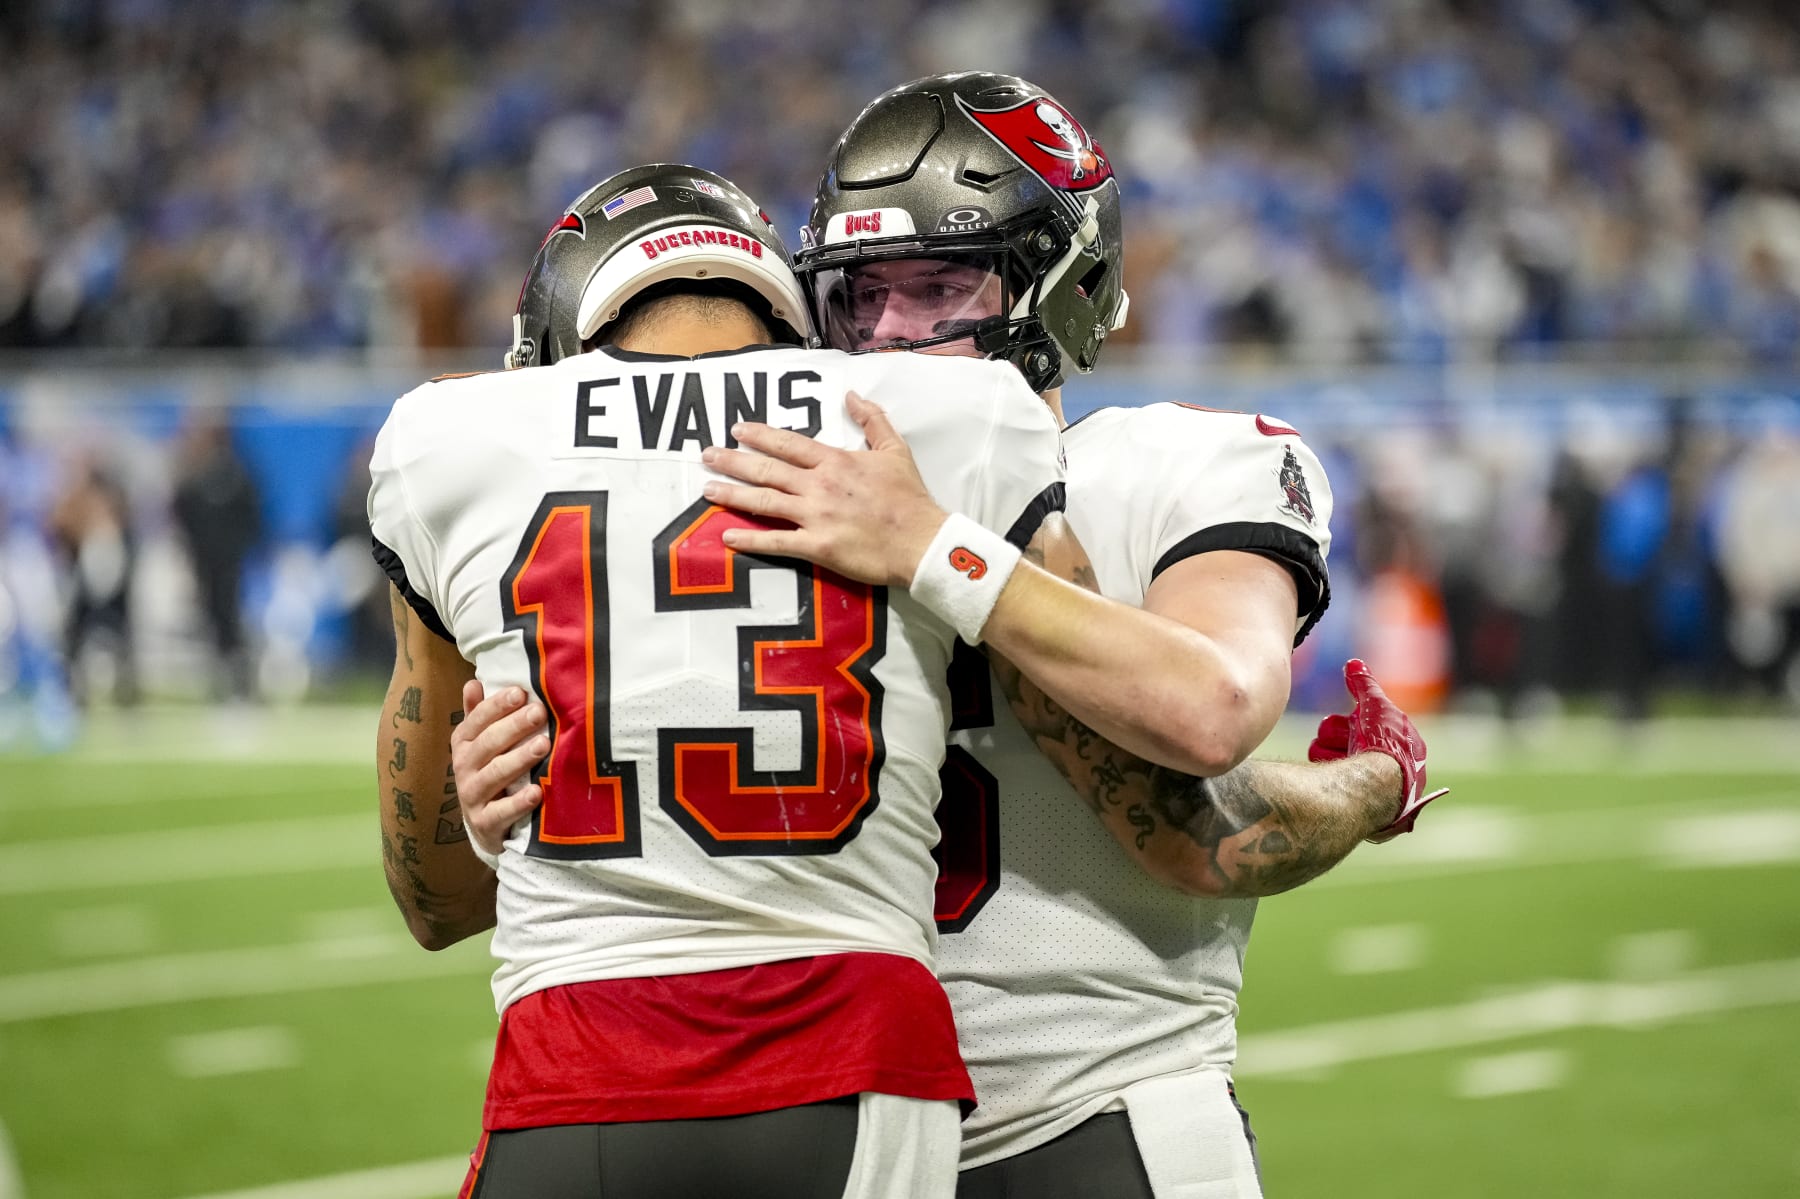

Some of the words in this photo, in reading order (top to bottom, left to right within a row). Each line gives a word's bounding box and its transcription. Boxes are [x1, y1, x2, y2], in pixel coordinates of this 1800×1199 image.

[845, 211, 881, 236] BUCS
[940, 221, 990, 233] OAKLEY
[639, 230, 763, 260] BUCCANEERS
[574, 370, 823, 453] EVANS
[499, 489, 888, 859] 13
